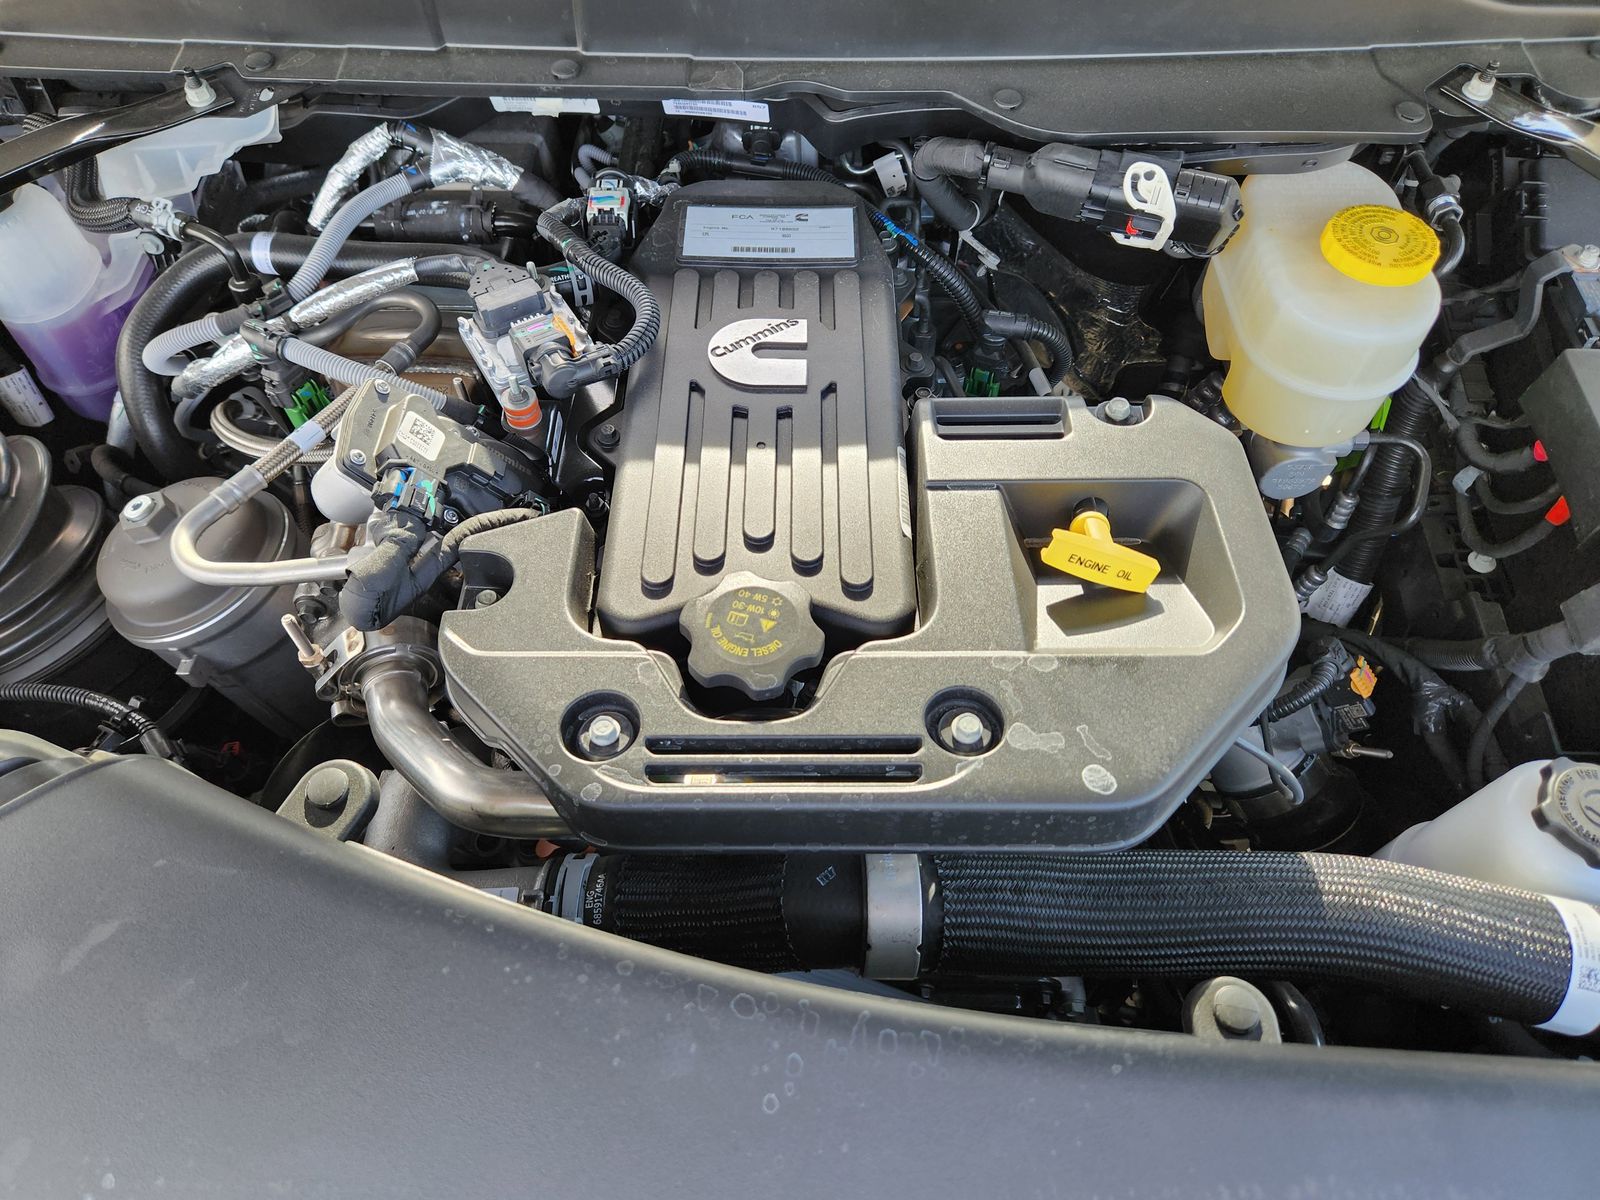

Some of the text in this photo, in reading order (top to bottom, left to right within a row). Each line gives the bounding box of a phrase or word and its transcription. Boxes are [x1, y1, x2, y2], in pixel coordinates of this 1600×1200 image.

[710, 319, 800, 358] Cummins
[1067, 553, 1132, 581] ENGINE OIL
[732, 600, 765, 615] 10W-30
[738, 589, 768, 603] 5W-40
[711, 623, 783, 657] DIESEL ENGINE OIL
[585, 890, 595, 909] ENG
[593, 873, 607, 925] 68591746AA
